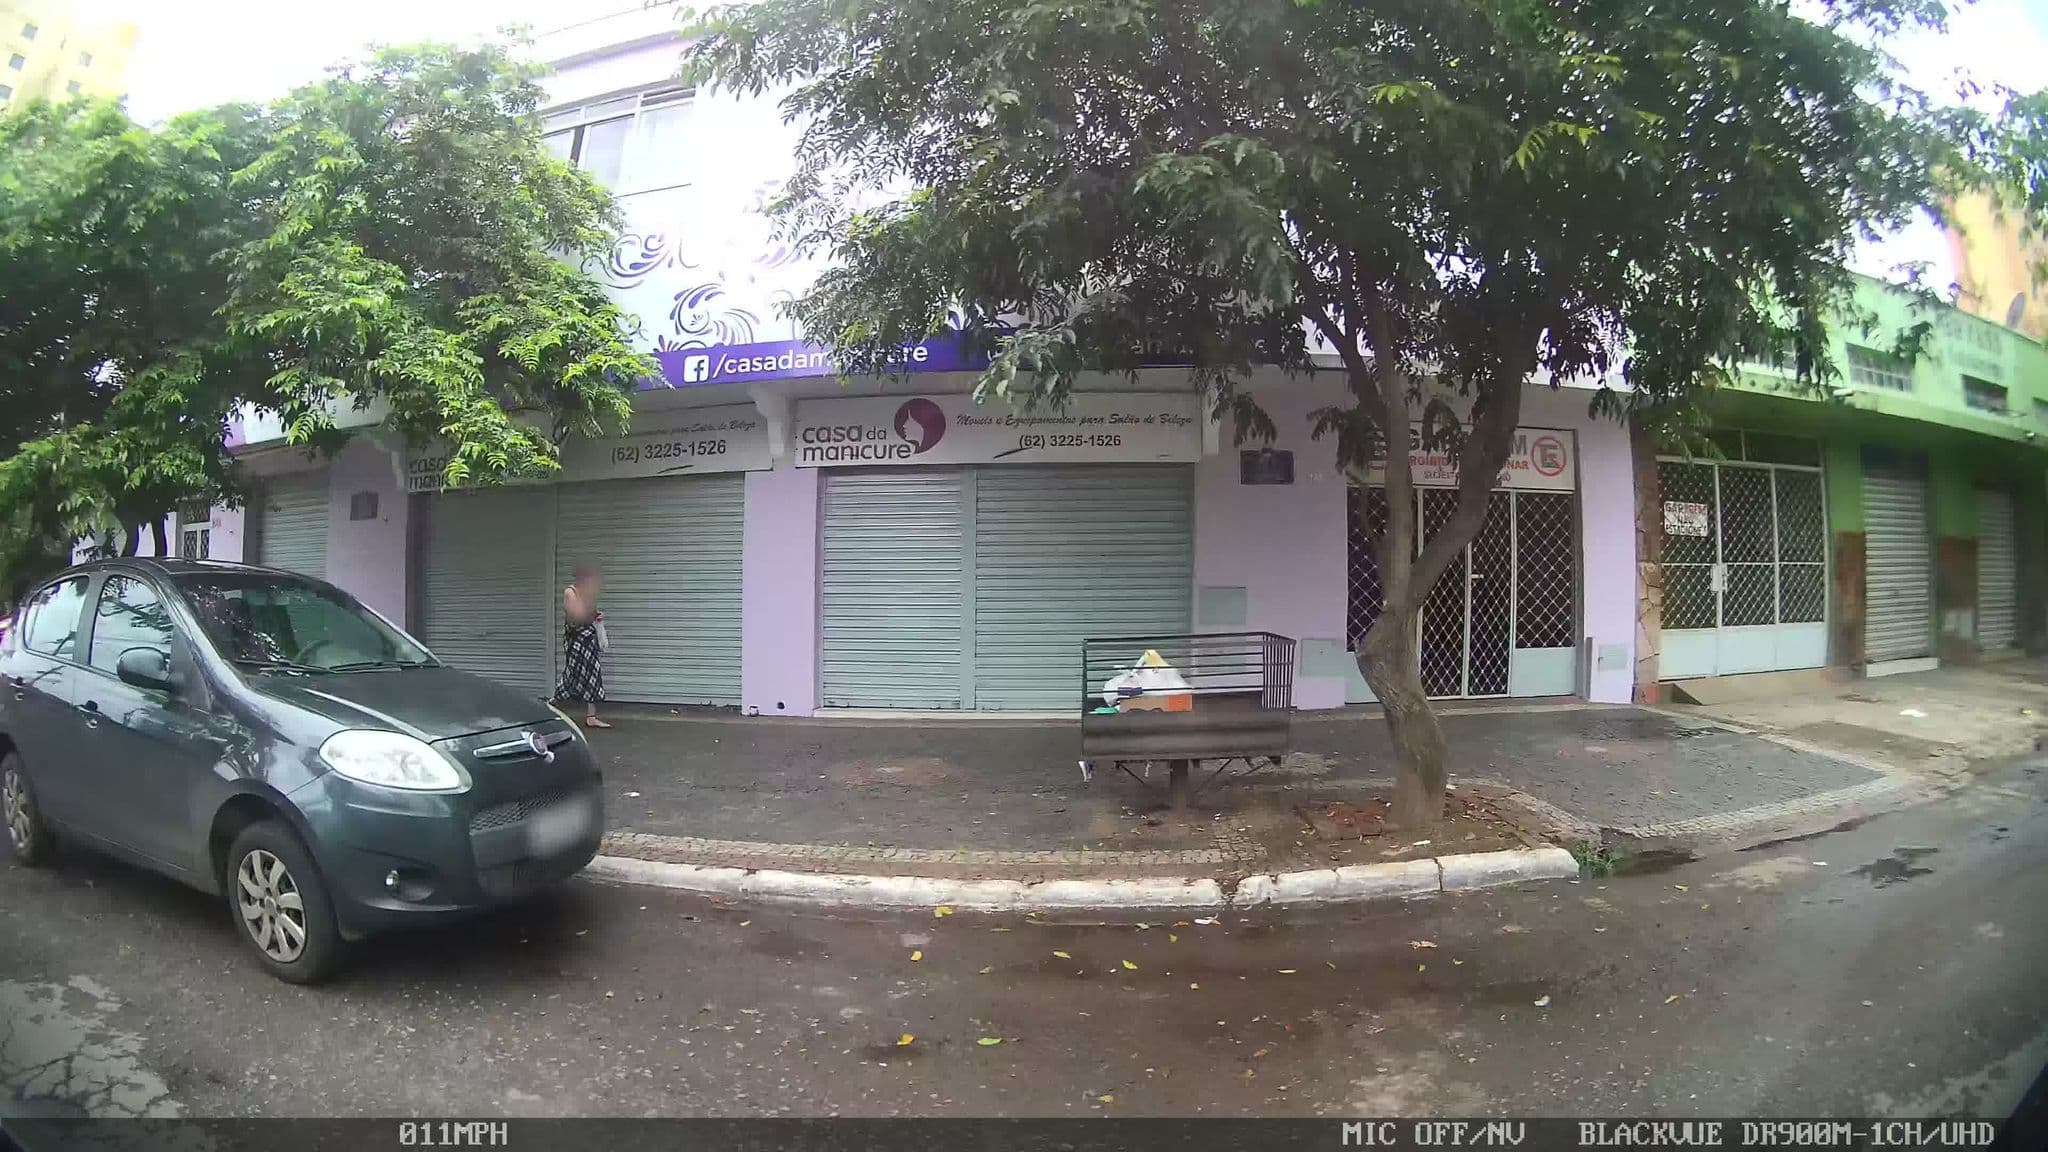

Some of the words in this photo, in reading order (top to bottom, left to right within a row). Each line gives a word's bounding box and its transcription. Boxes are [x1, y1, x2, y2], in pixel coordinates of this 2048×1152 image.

[802, 424, 863, 444] casa
[866, 426, 887, 441] da
[1019, 434, 1046, 449] (62)
[1050, 434, 1122, 447] 3225-1526
[611, 446, 640, 465] (62)
[644, 439, 727, 459] 3225-1526
[802, 442, 912, 462] manicure
